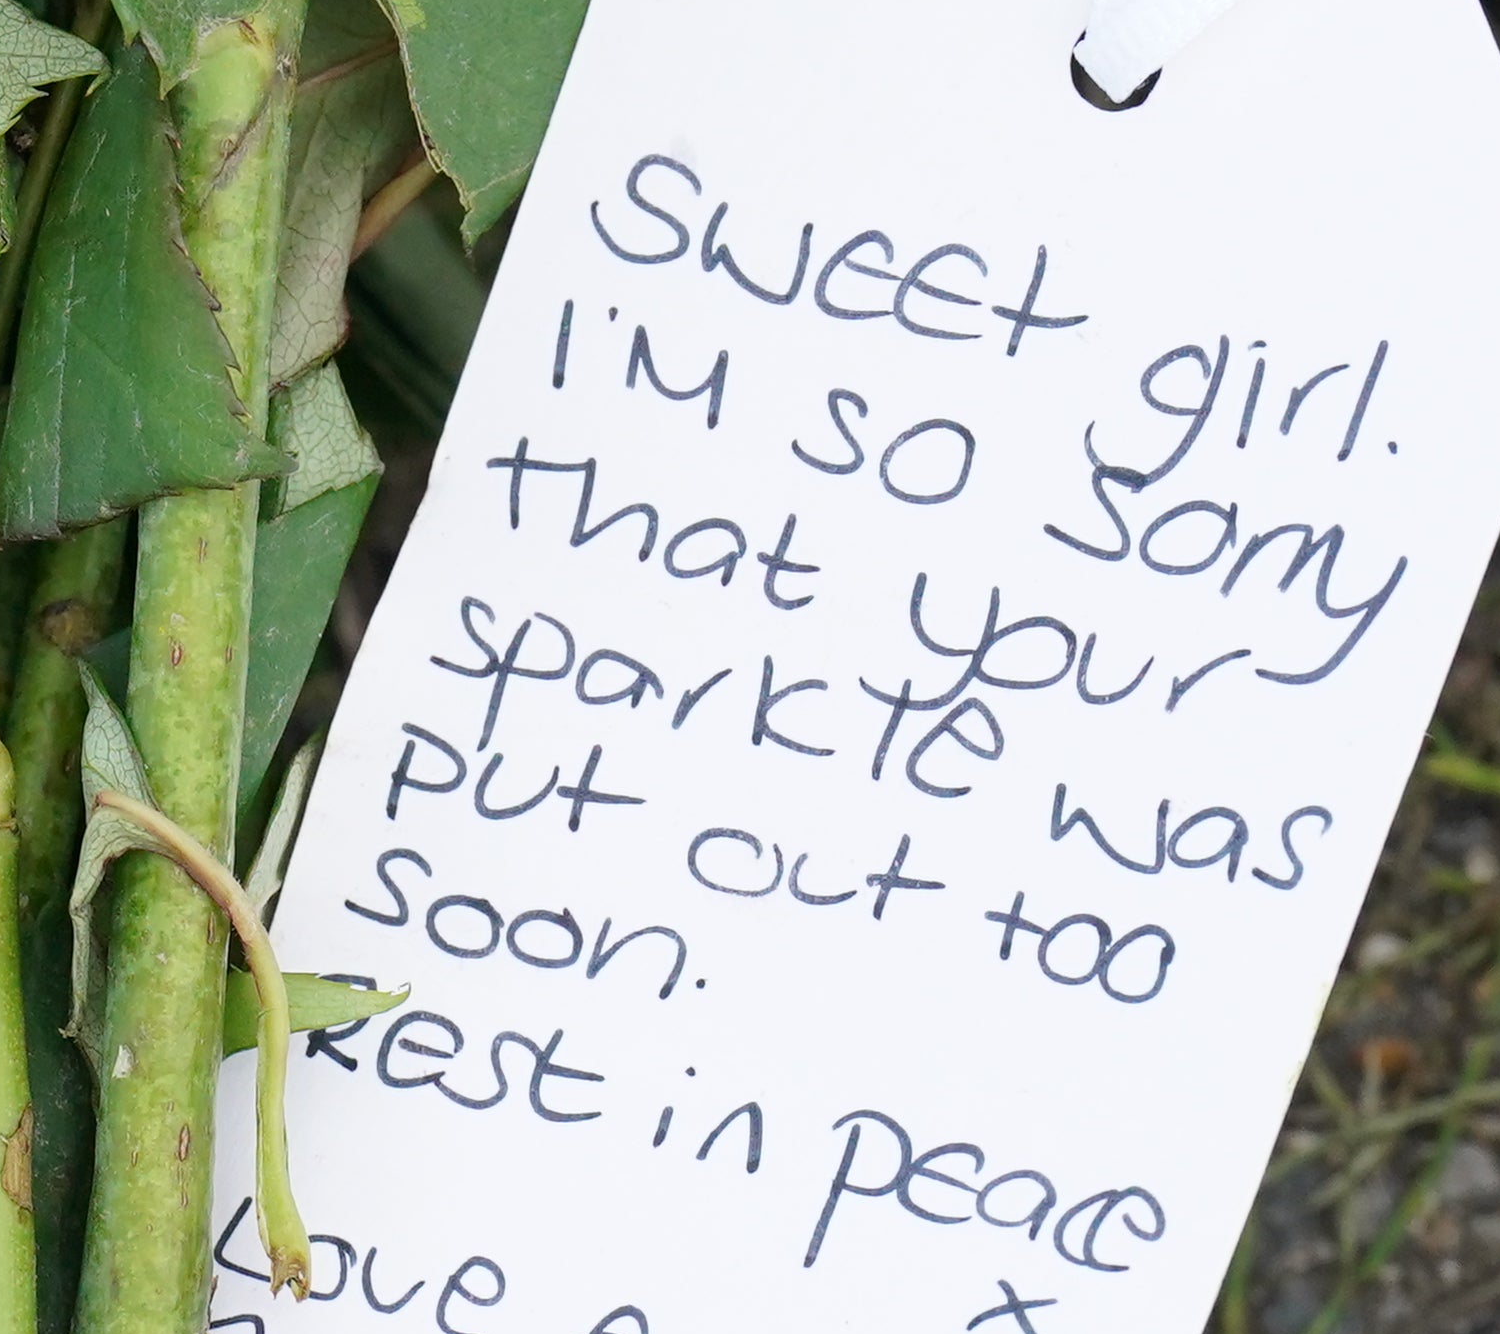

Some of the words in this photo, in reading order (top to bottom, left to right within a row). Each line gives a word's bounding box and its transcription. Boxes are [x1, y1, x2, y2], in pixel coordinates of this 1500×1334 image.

[1085, 334, 1401, 489] girl.
[485, 434, 820, 612] that
[857, 570, 1253, 717] your
[685, 825, 948, 921] out
[985, 888, 1177, 1005] too
[1048, 781, 1334, 892] was
[650, 1064, 763, 1176] in
[802, 1108, 1168, 1273] peace
